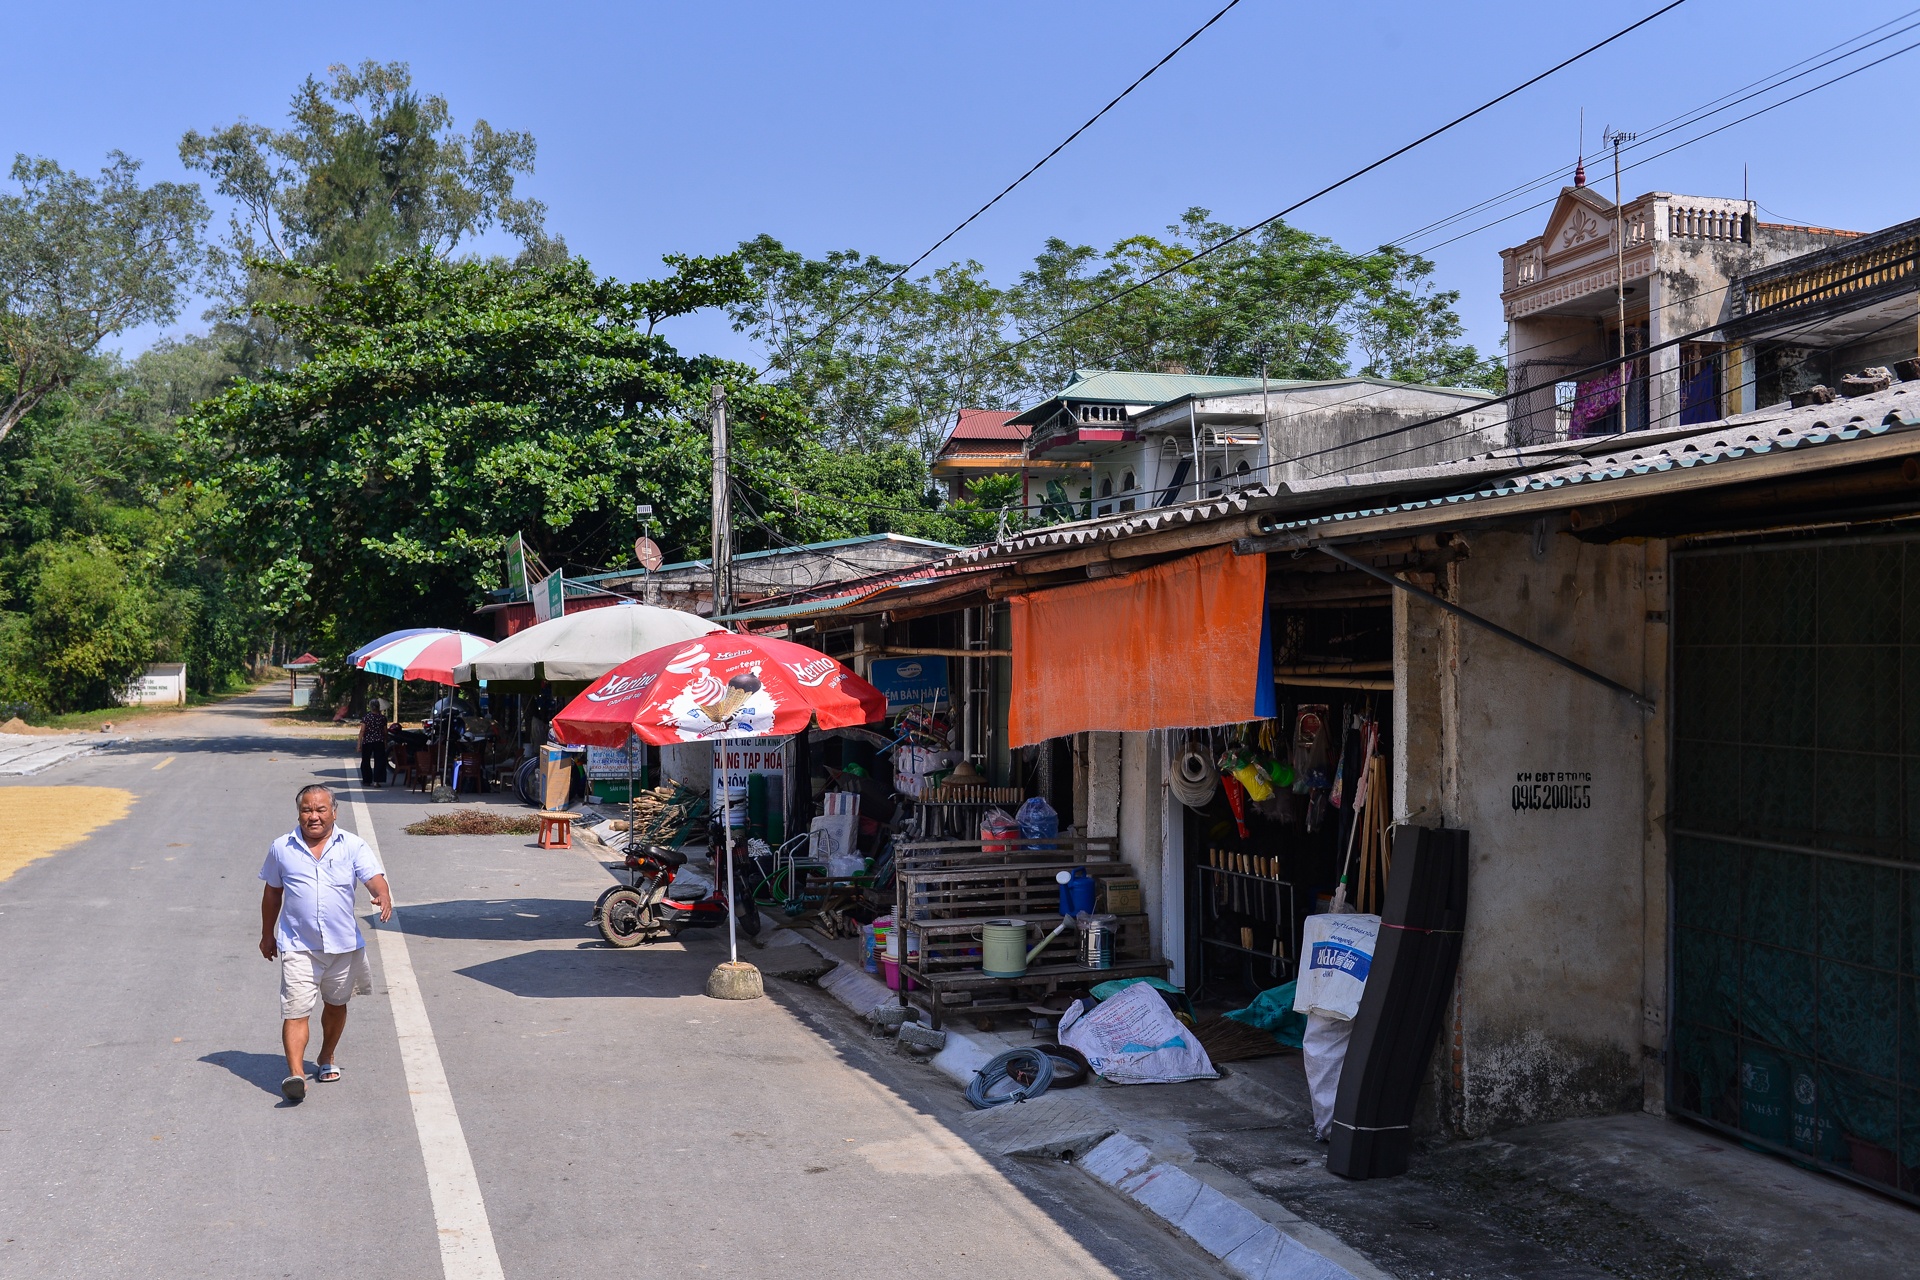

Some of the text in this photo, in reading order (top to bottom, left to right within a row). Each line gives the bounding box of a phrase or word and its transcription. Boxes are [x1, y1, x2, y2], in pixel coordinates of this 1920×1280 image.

[715, 649, 753, 660] Merino
[784, 657, 837, 685] Merino
[588, 672, 658, 700] Merino
[901, 687, 919, 700] BÁN
[743, 752, 761, 772] TẠP
[1517, 772, 1532, 782] KH
[1535, 772, 1555, 782] CBT
[1512, 784, 1591, 811] 0915200155
